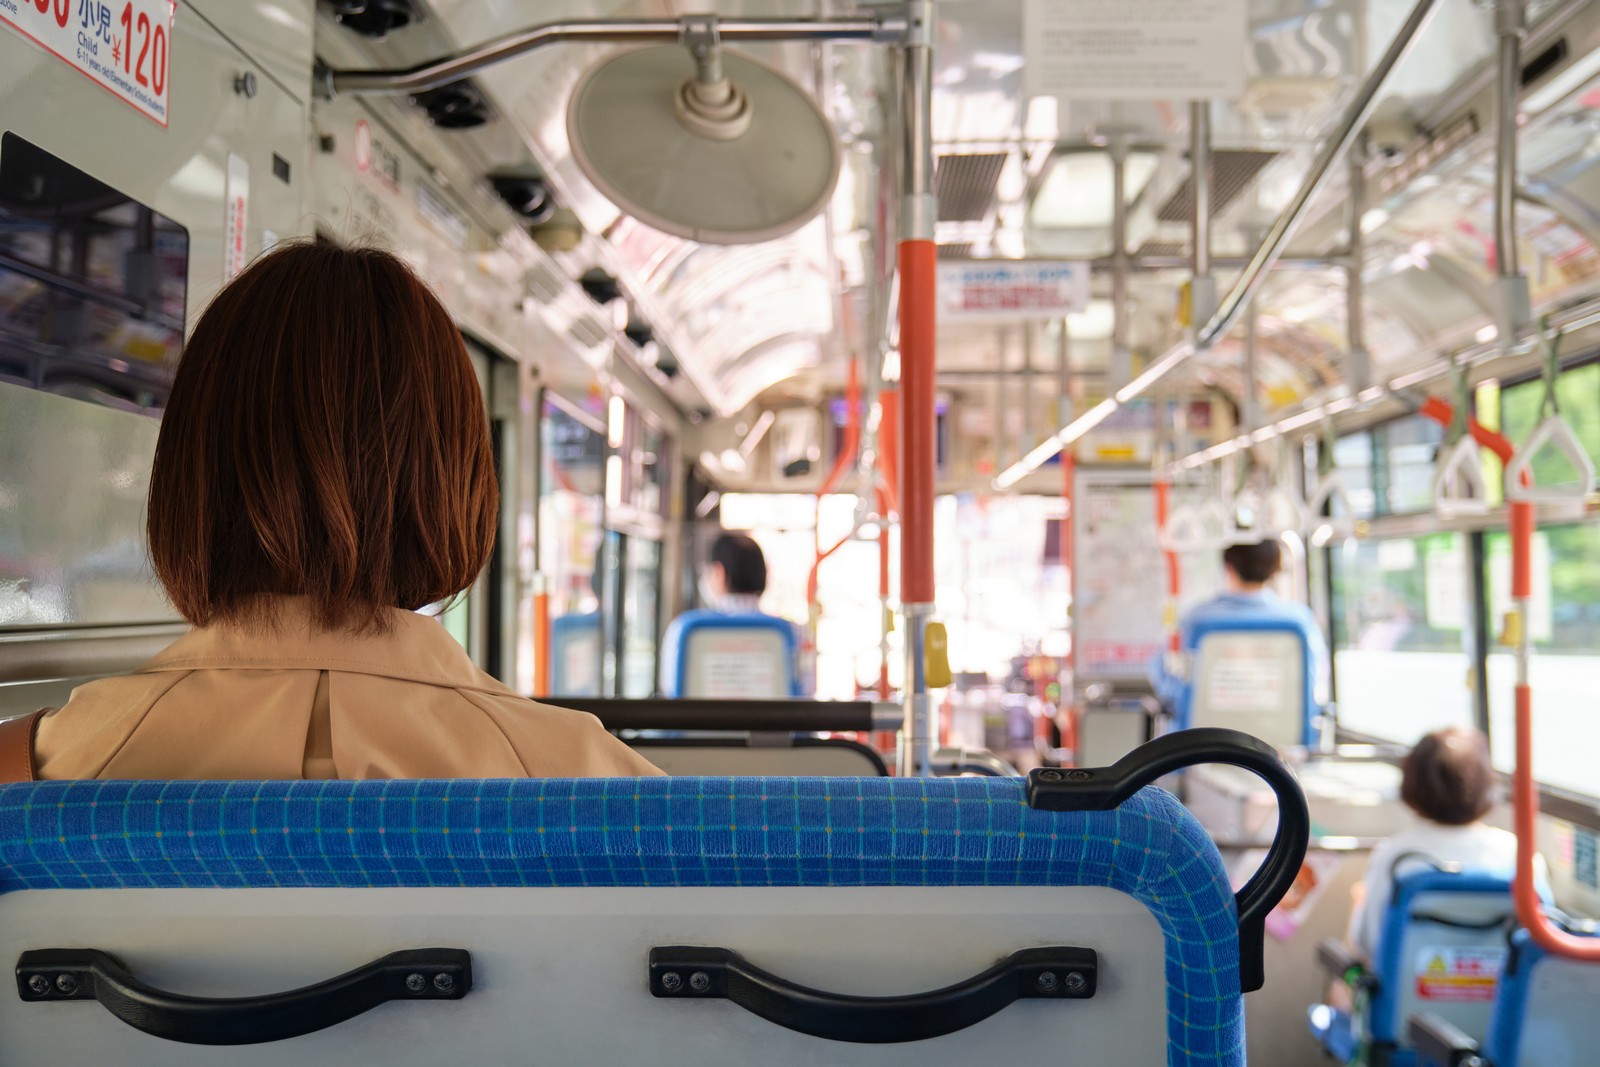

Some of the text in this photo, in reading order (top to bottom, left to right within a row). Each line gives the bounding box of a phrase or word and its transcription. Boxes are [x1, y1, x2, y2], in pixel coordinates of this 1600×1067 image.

[78, 0, 111, 44] 小児
[76, 47, 89, 65] 6-11
[77, 31, 98, 56] Child
